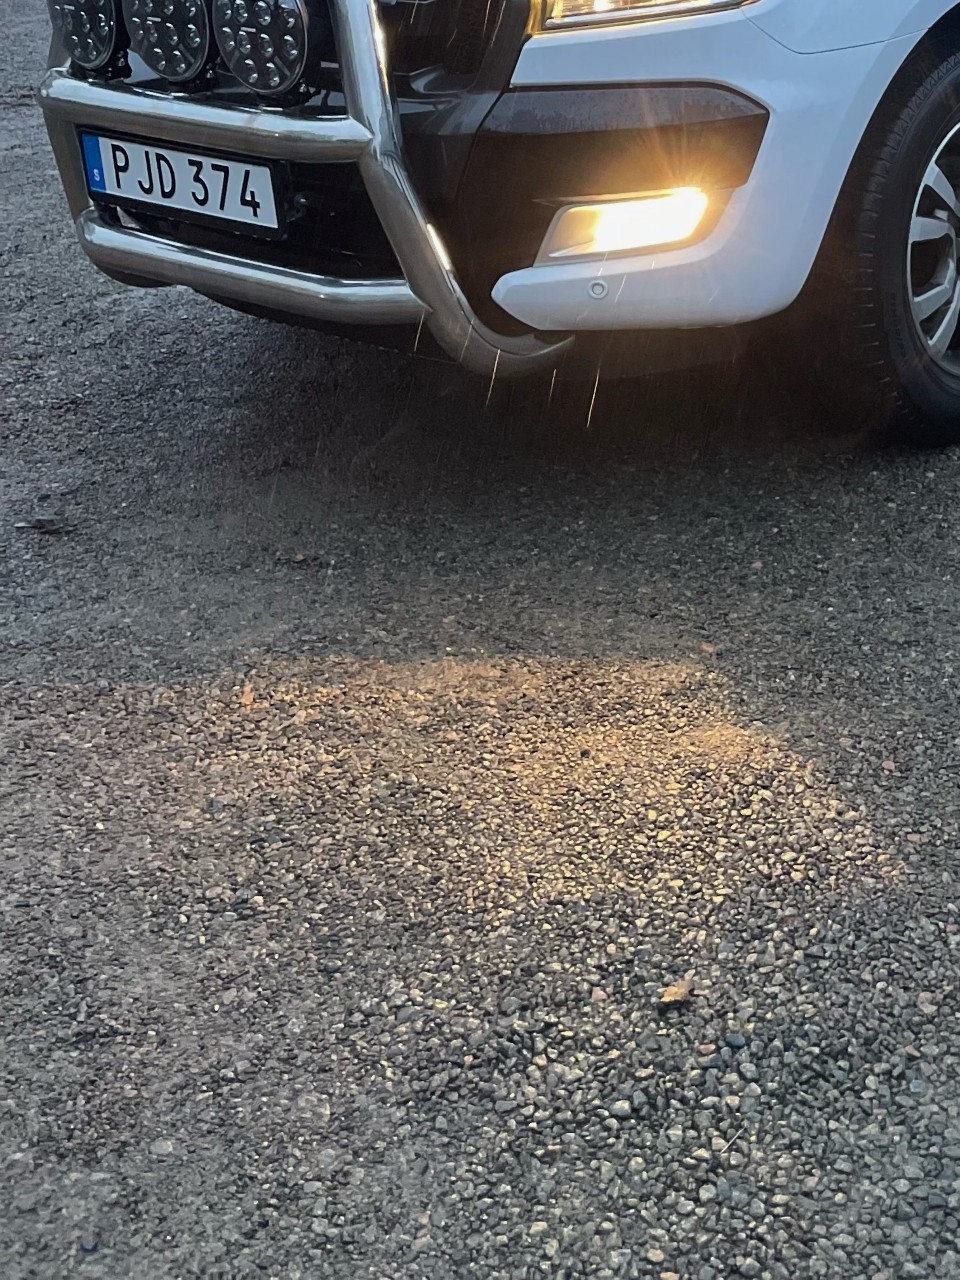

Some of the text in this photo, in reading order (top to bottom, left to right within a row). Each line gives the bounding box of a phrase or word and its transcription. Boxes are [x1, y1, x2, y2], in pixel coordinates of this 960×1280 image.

[93, 169, 100, 181] S
[111, 144, 260, 217] PJD 374
